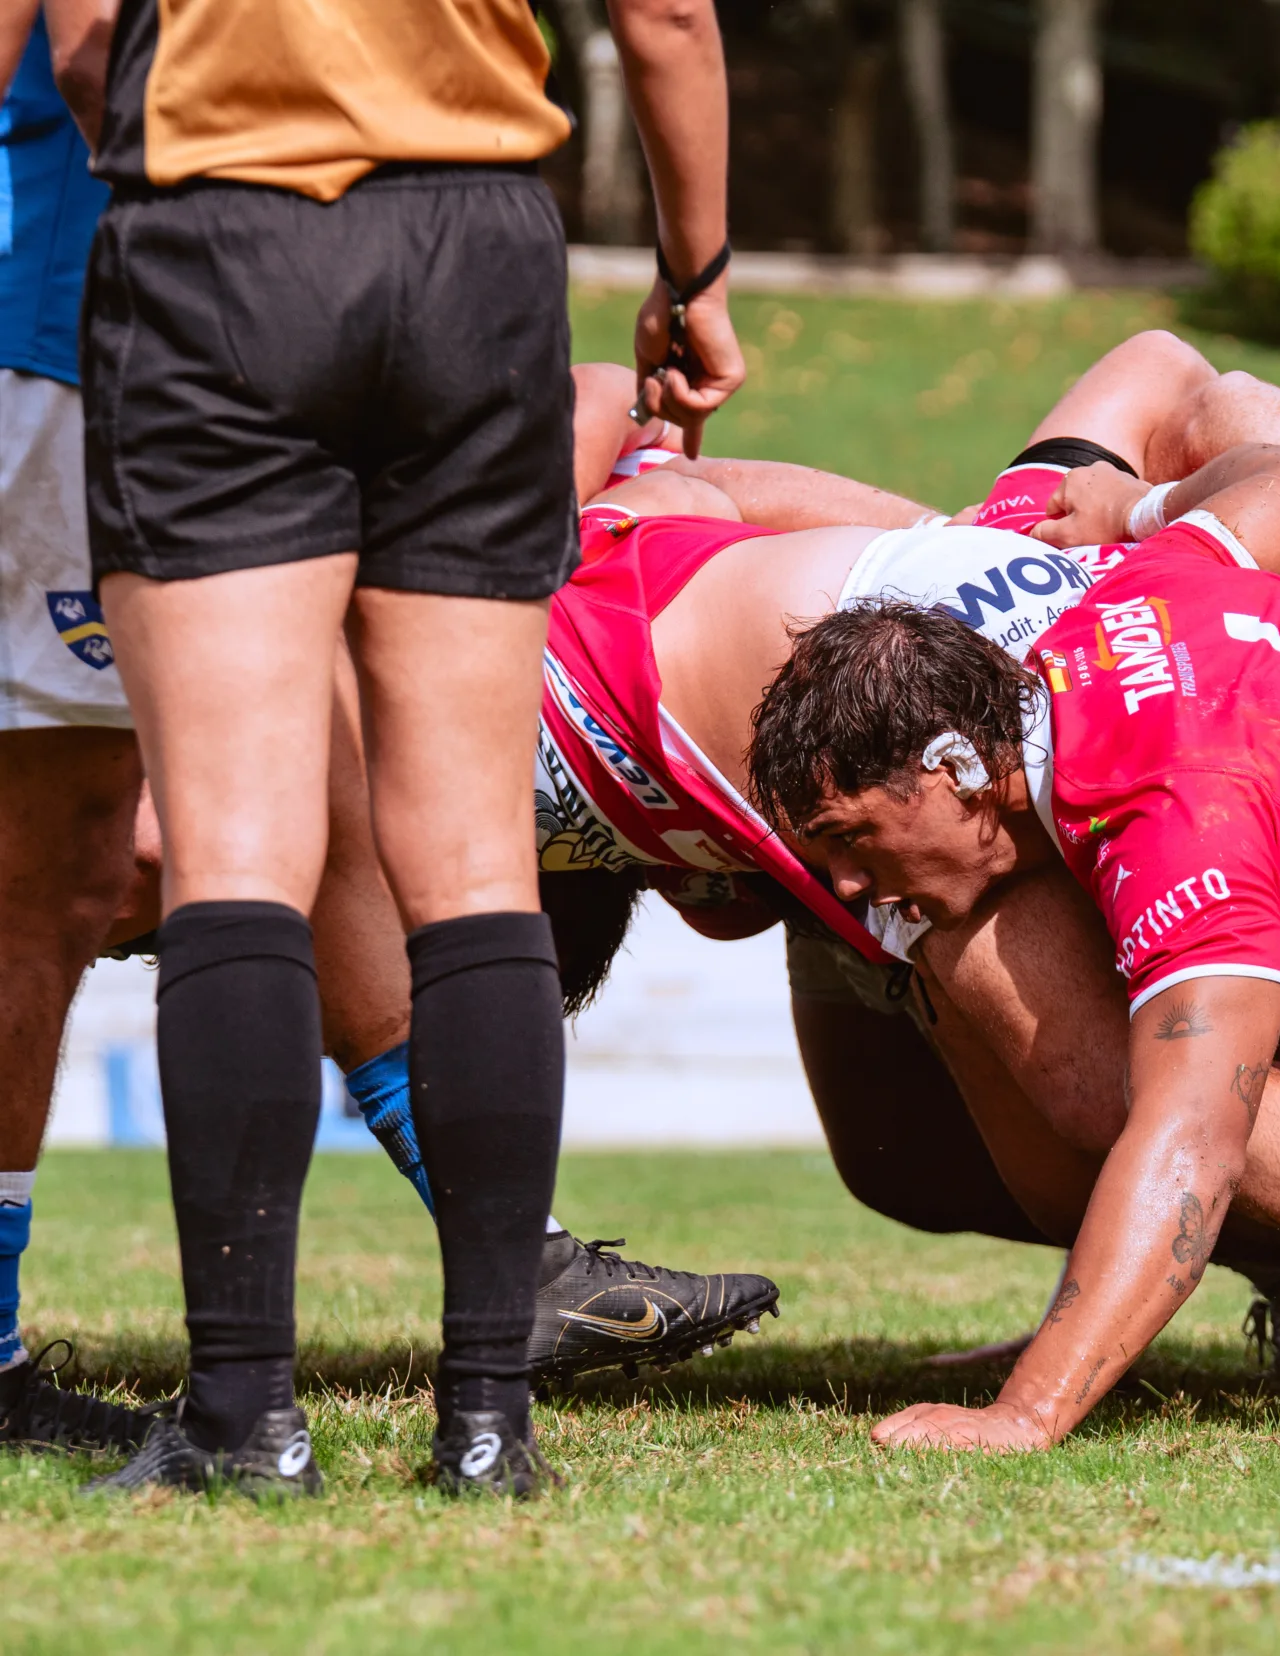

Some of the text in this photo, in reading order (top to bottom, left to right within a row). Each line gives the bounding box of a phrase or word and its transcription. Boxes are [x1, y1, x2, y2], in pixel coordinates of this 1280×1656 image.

[973, 494, 1035, 525] VALLA
[927, 552, 1094, 632] WOR
[992, 617, 1037, 650] udit
